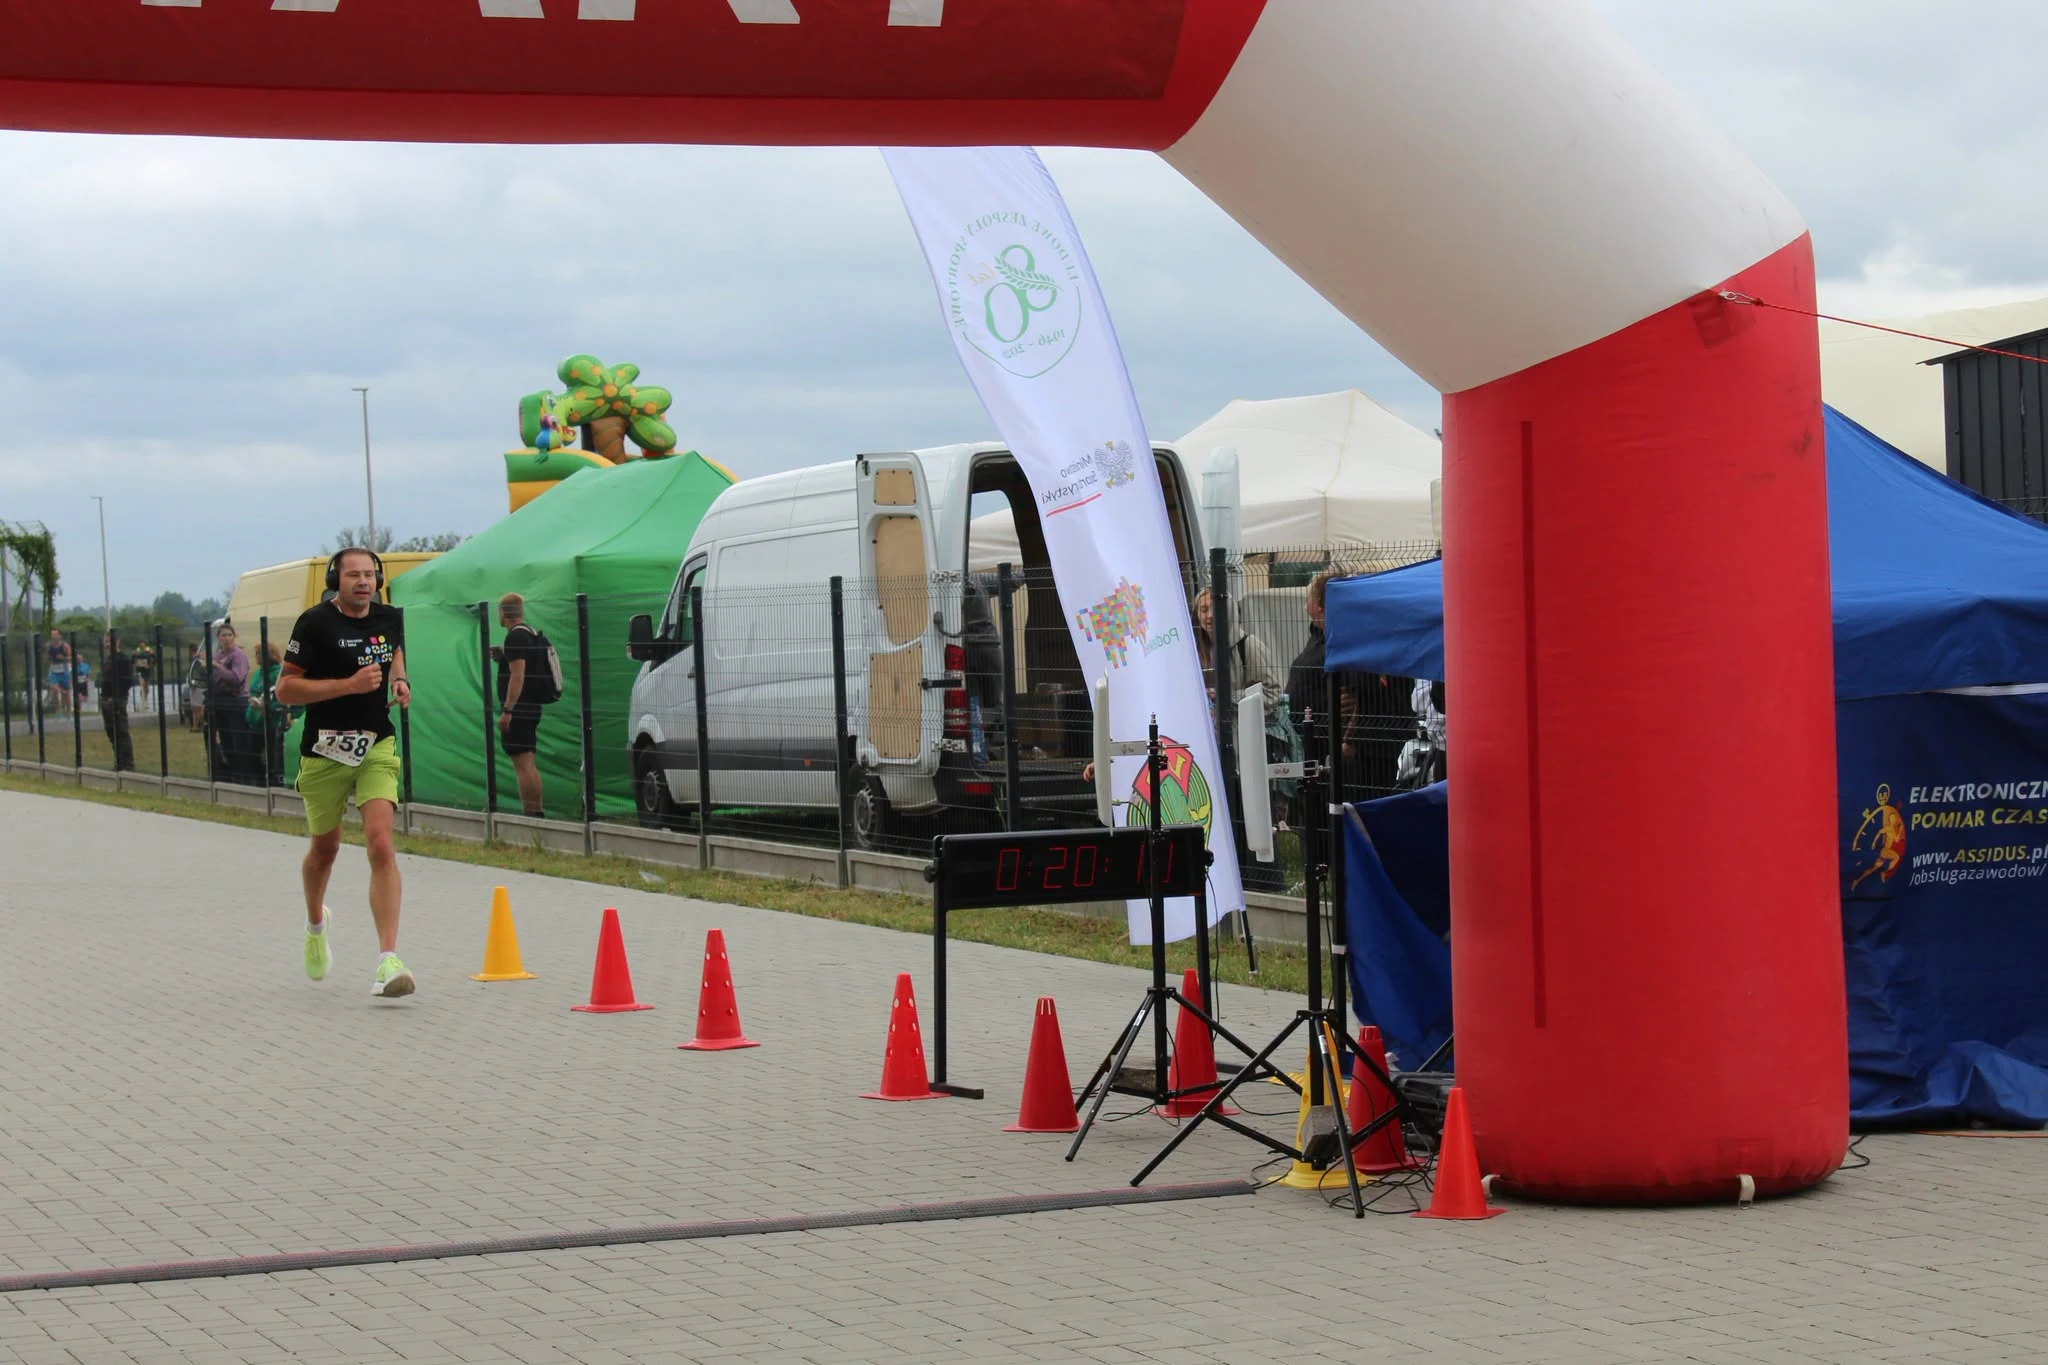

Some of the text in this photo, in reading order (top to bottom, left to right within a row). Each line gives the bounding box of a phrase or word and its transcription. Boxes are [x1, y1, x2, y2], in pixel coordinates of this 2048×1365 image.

[326, 736, 369, 757] 758
[1911, 808, 2048, 830] POMIAR CZAS
[1912, 844, 2048, 868] www.ASSIDUS.pl
[1908, 864, 2046, 887] /obslugazawodow/
